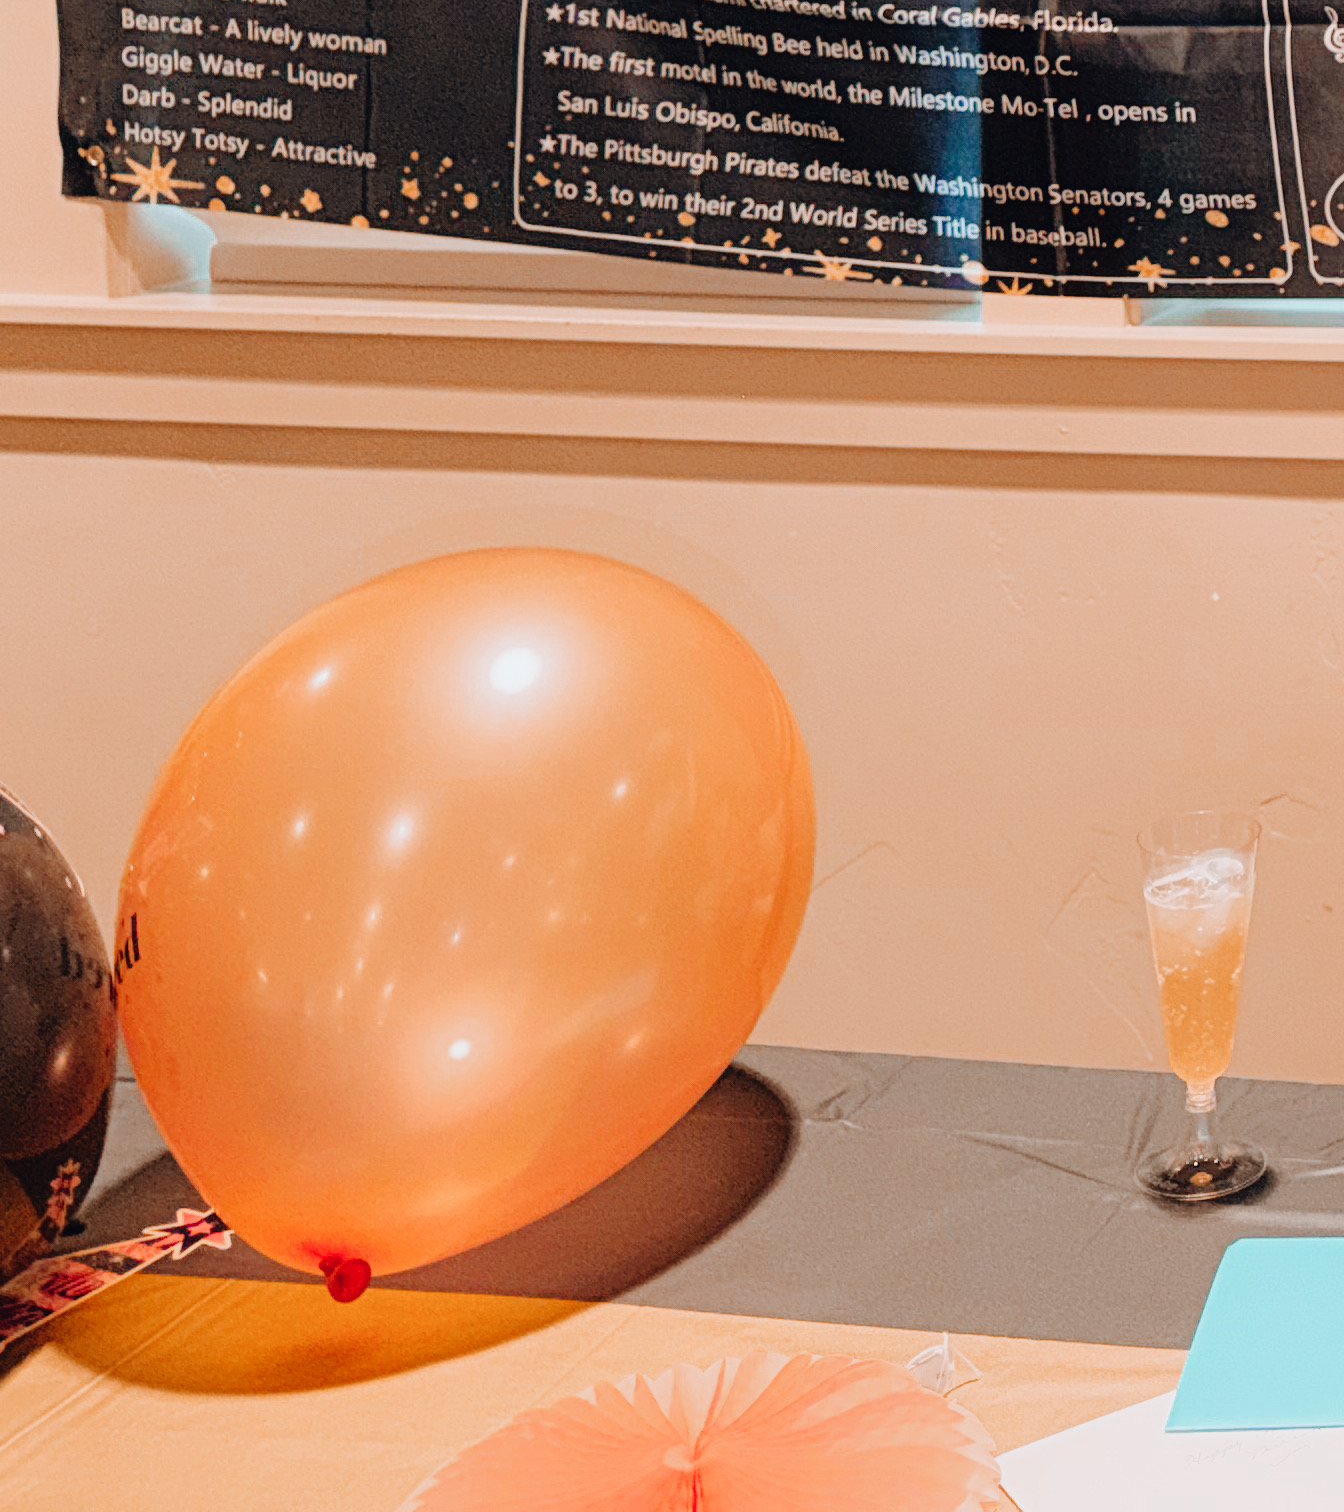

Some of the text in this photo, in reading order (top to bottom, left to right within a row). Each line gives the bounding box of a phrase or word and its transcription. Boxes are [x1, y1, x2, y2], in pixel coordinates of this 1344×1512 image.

[121, 8, 387, 56] Bearcat A lively woman
[121, 45, 358, 92] Giggle Water Liquor
[122, 83, 292, 122] Darb Splendid
[557, 90, 845, 143] San Luis Obispo, California.
[124, 121, 376, 169] Hotsy Totsy Attractive
